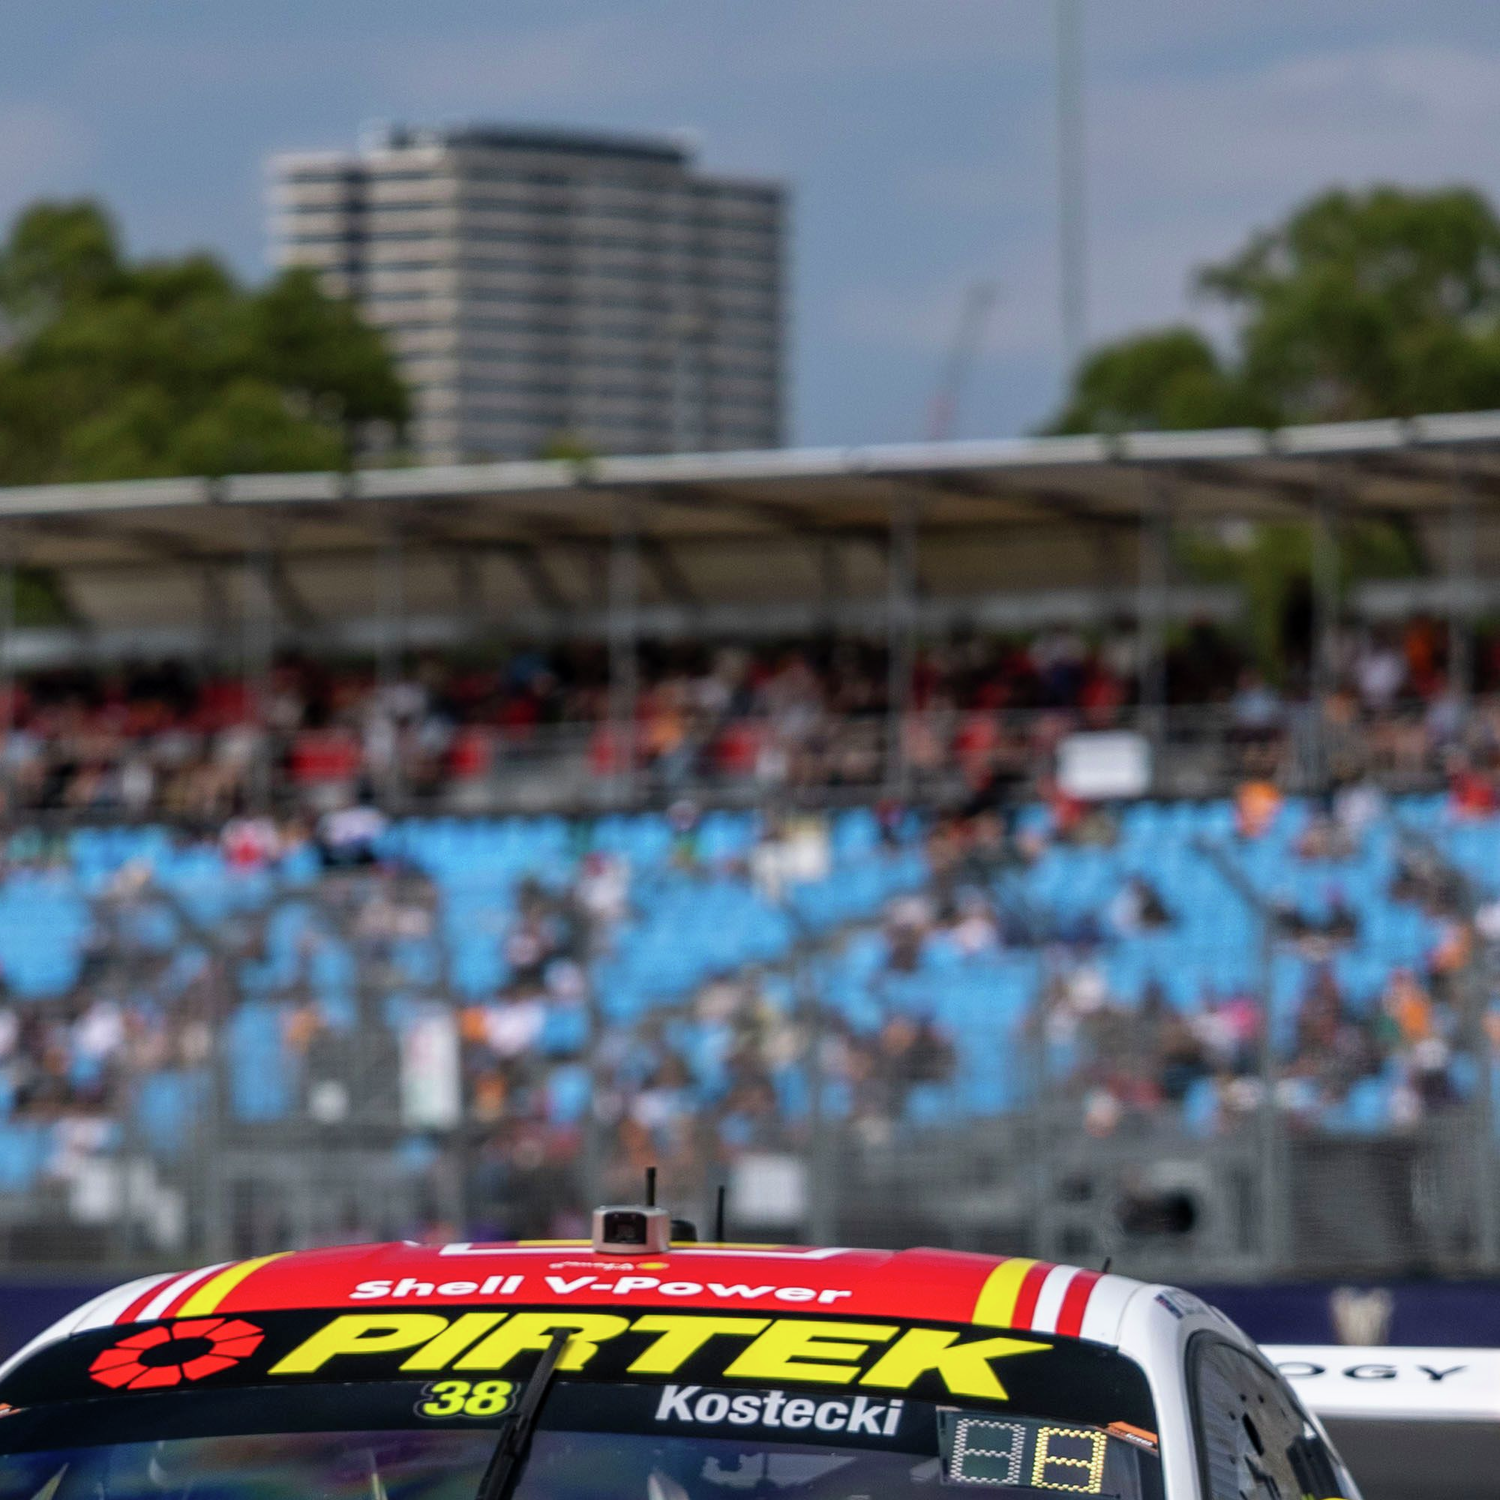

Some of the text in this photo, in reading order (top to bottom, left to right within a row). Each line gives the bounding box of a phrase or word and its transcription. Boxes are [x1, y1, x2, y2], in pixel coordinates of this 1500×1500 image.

[349, 1275, 852, 1304] Shell V-Power
[267, 1311, 1054, 1401] PIRTEK
[423, 1380, 513, 1416] 38
[654, 1384, 903, 1436] Kostecki
